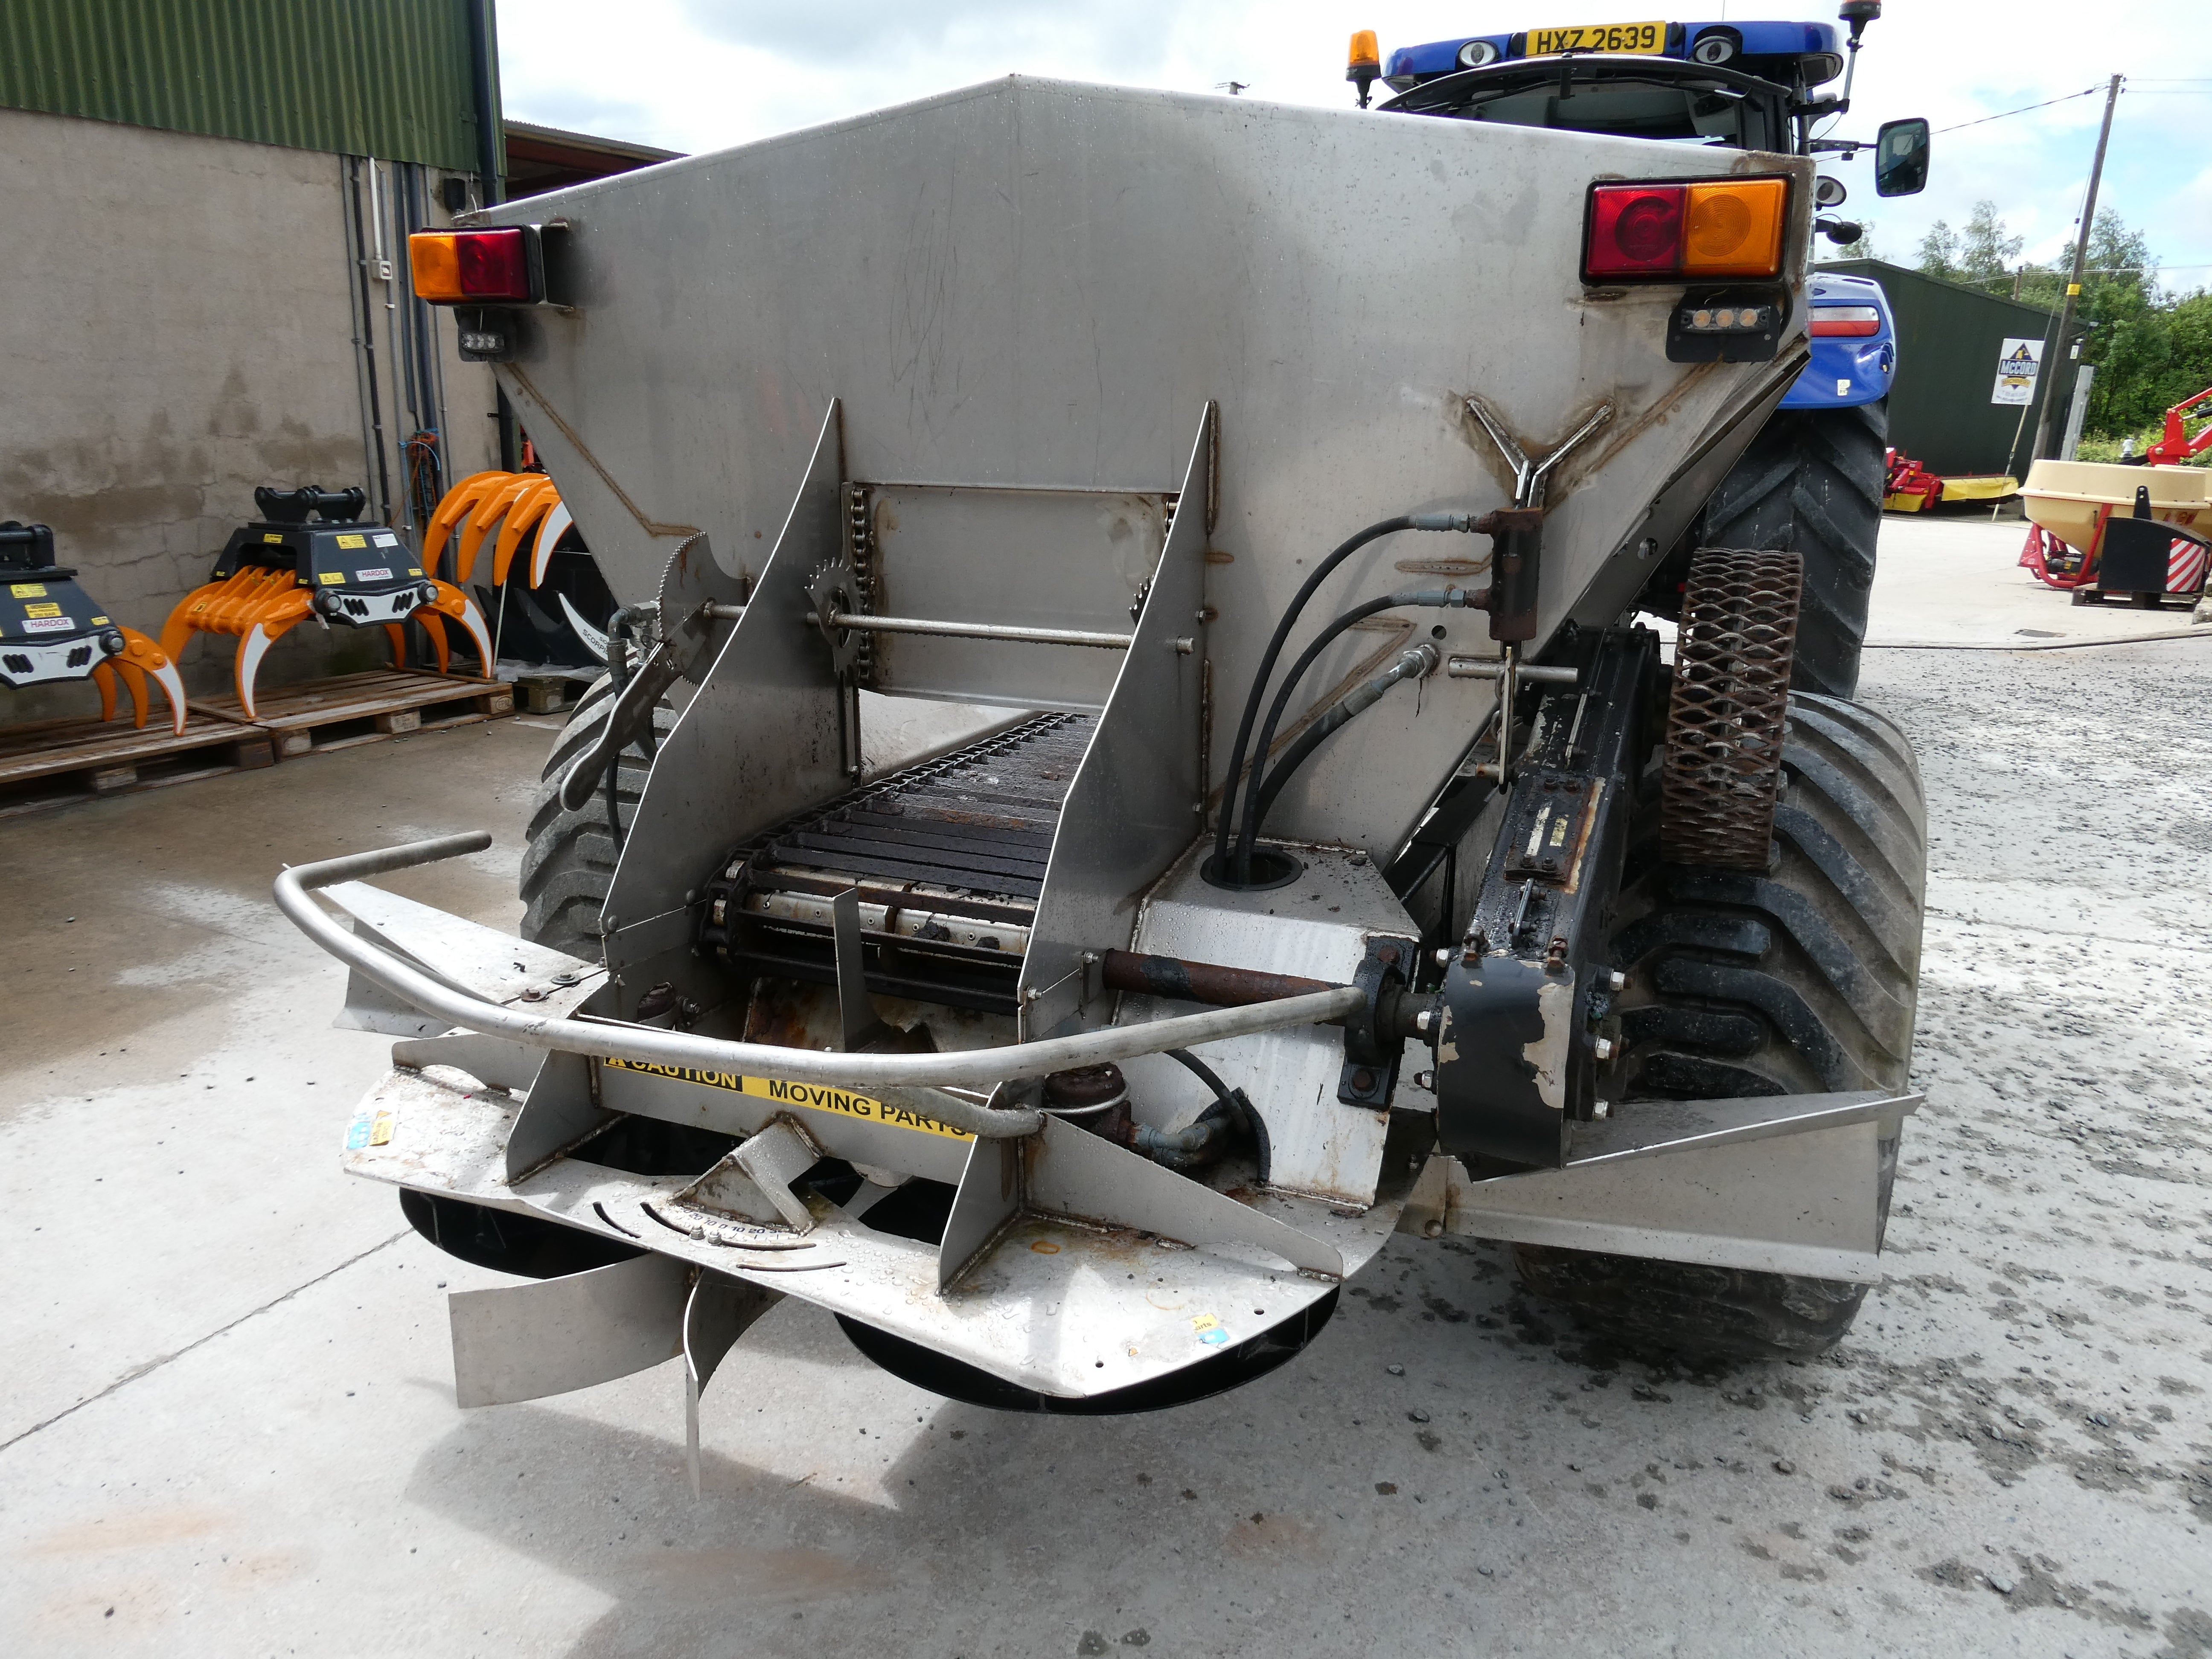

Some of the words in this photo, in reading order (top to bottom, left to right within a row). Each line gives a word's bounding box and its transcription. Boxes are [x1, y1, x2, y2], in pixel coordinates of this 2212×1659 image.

[1537, 29, 1584, 54] HXZ
[1592, 25, 1655, 51] 2639
[30, 619, 69, 628] HARDOX
[769, 1080, 871, 1115] MOVING
